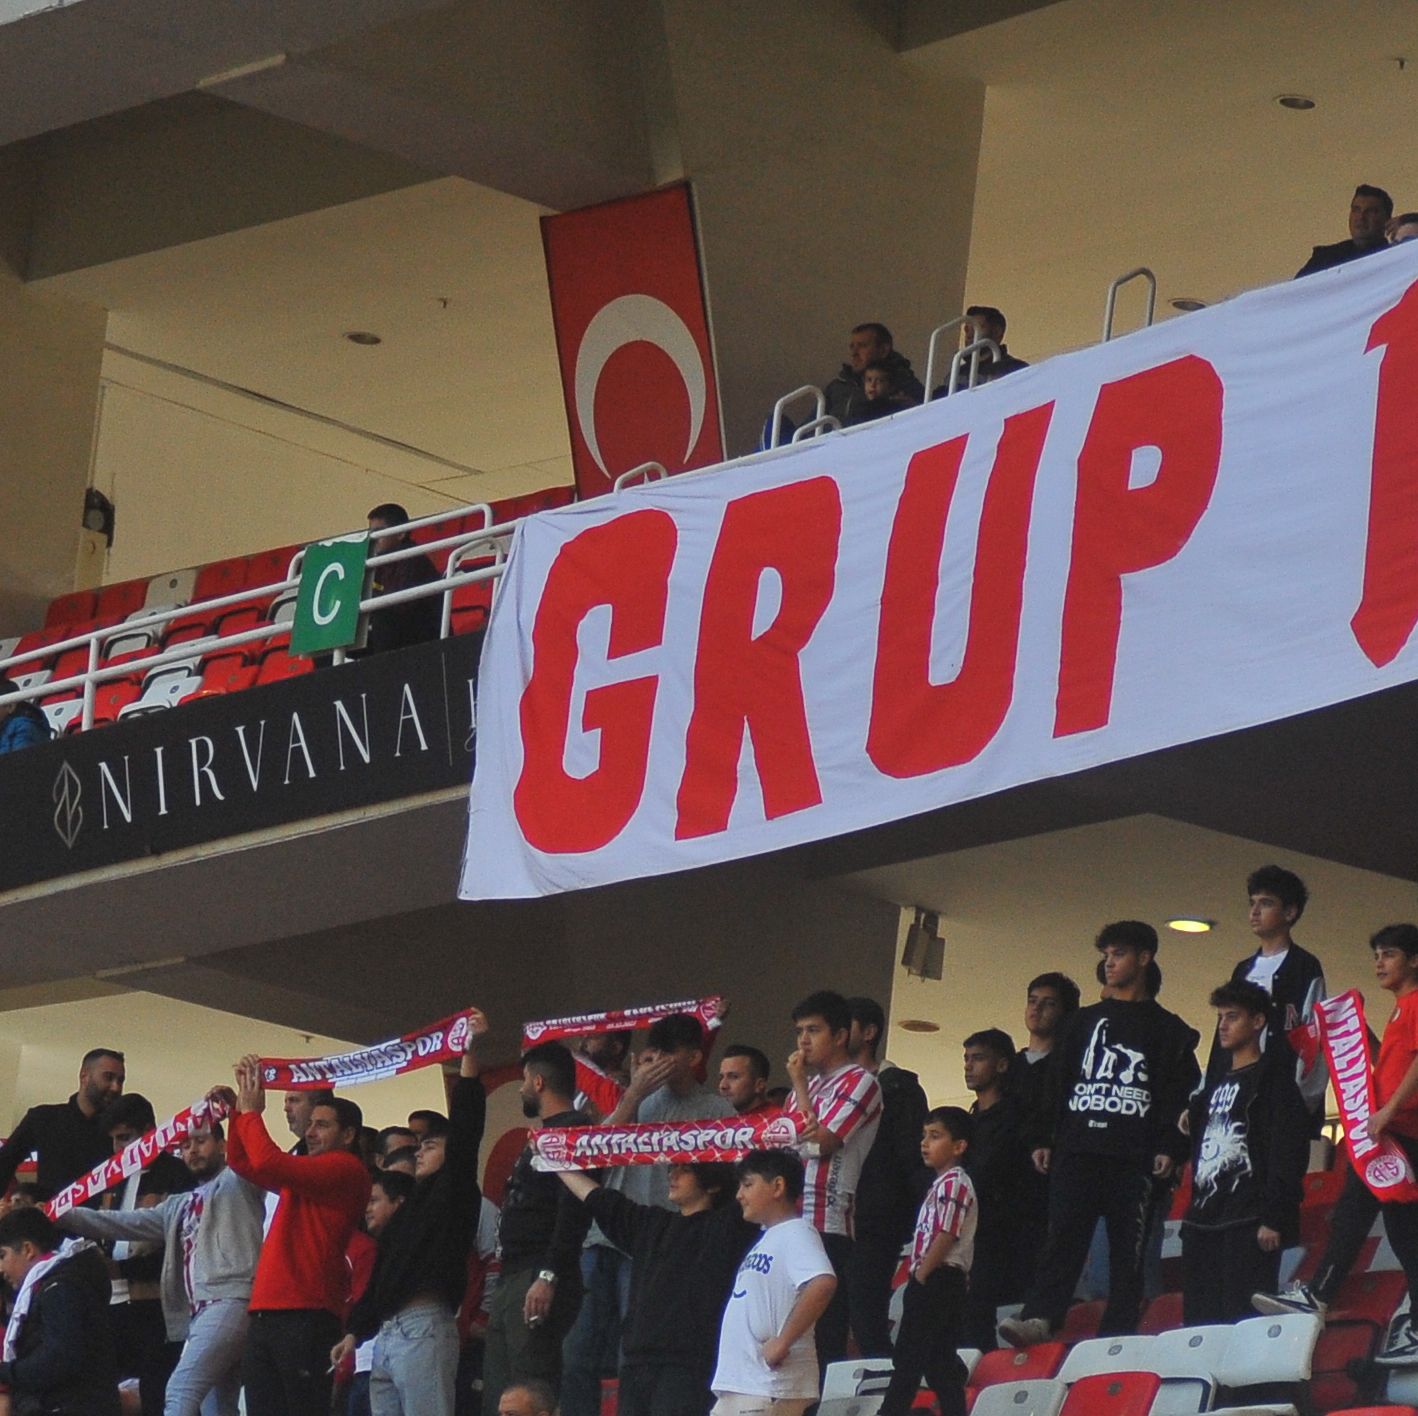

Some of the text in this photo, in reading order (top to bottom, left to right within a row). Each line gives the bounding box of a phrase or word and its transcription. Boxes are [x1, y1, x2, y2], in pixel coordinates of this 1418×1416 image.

[312, 562, 346, 626] C
[514, 354, 1224, 854] GRUP
[98, 683, 429, 829] NIRVANA
[289, 1031, 445, 1083] ANTALYASPOR
[1068, 1095, 1151, 1118] NOBODY
[1112, 1084, 1152, 1103] NEED
[574, 1126, 757, 1157] ANTALYASPOR
